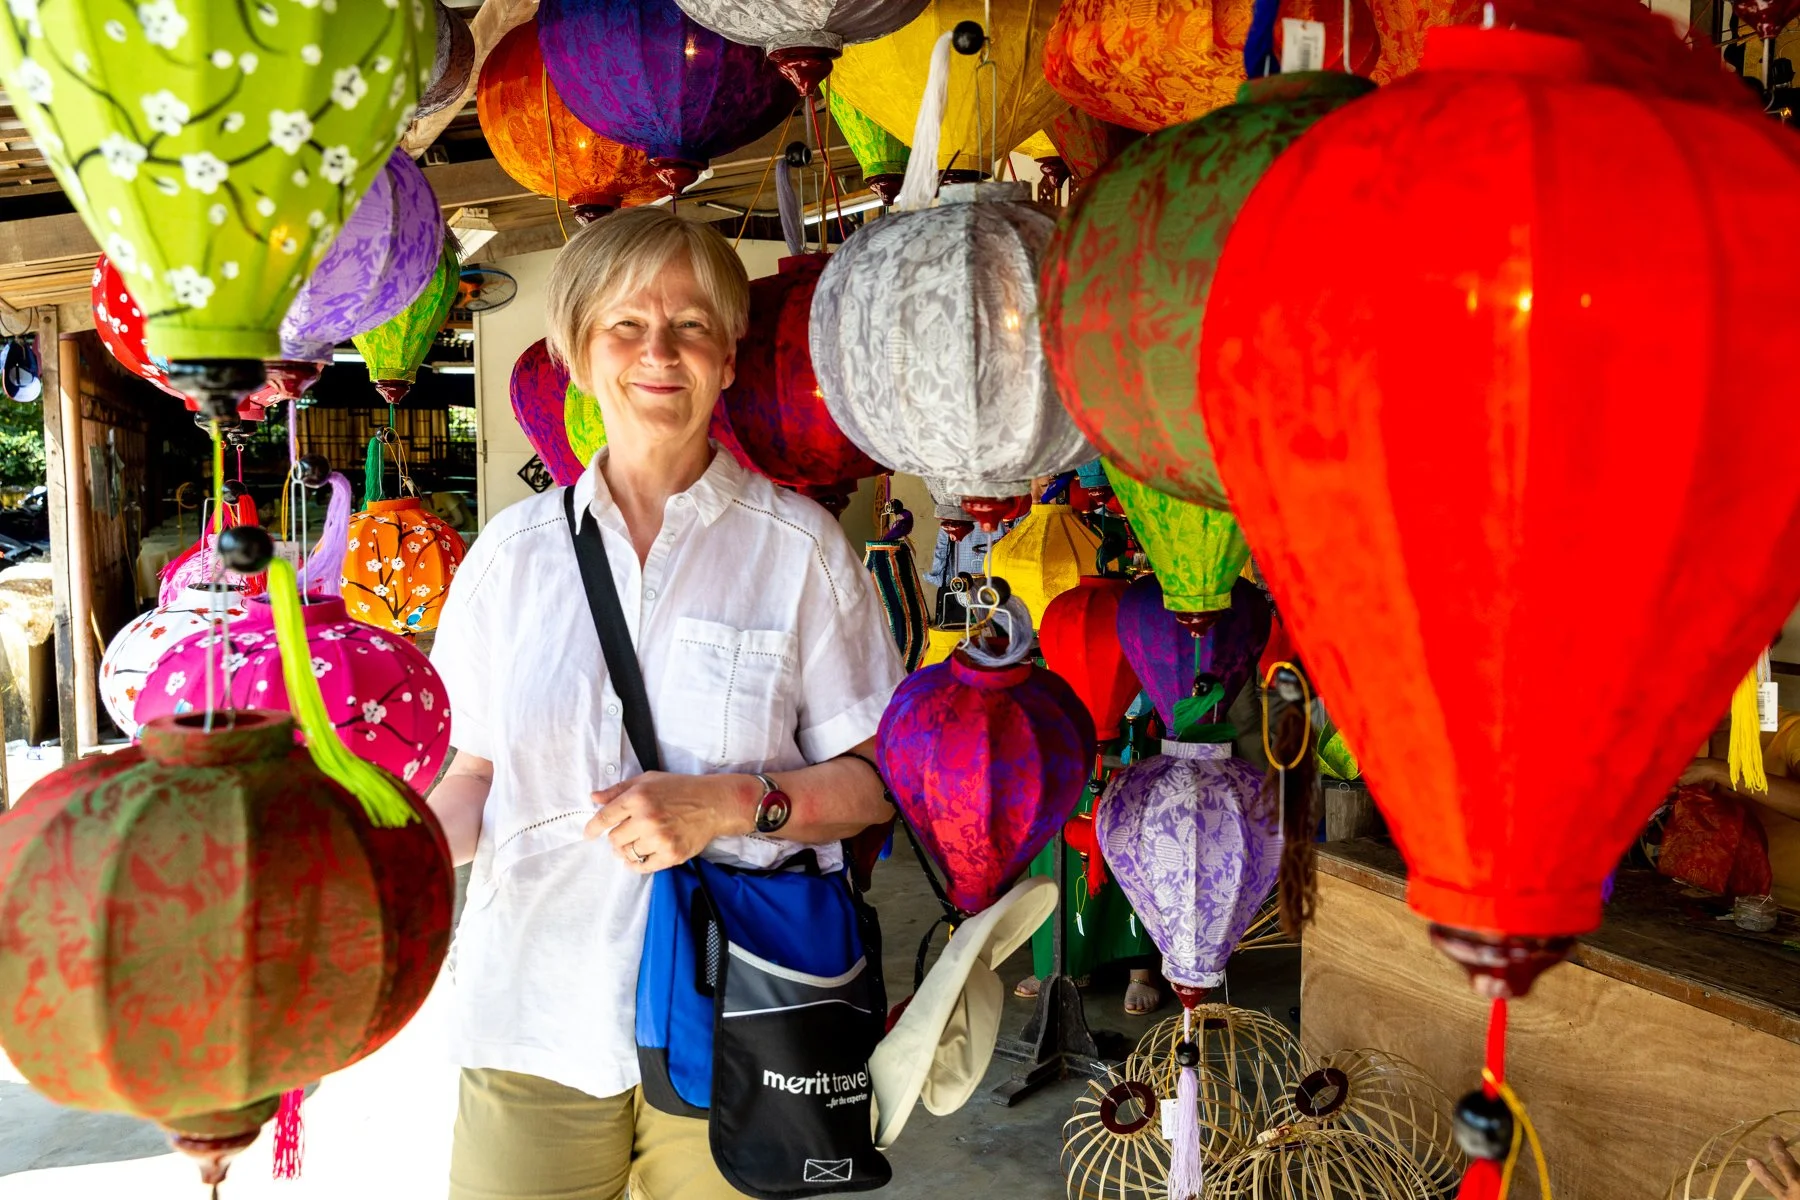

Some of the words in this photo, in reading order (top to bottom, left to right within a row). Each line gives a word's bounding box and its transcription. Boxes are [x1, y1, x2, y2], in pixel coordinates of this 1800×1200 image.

[763, 1069, 830, 1095] merit
[832, 1062, 869, 1093] travel
[838, 1096, 847, 1105] the
